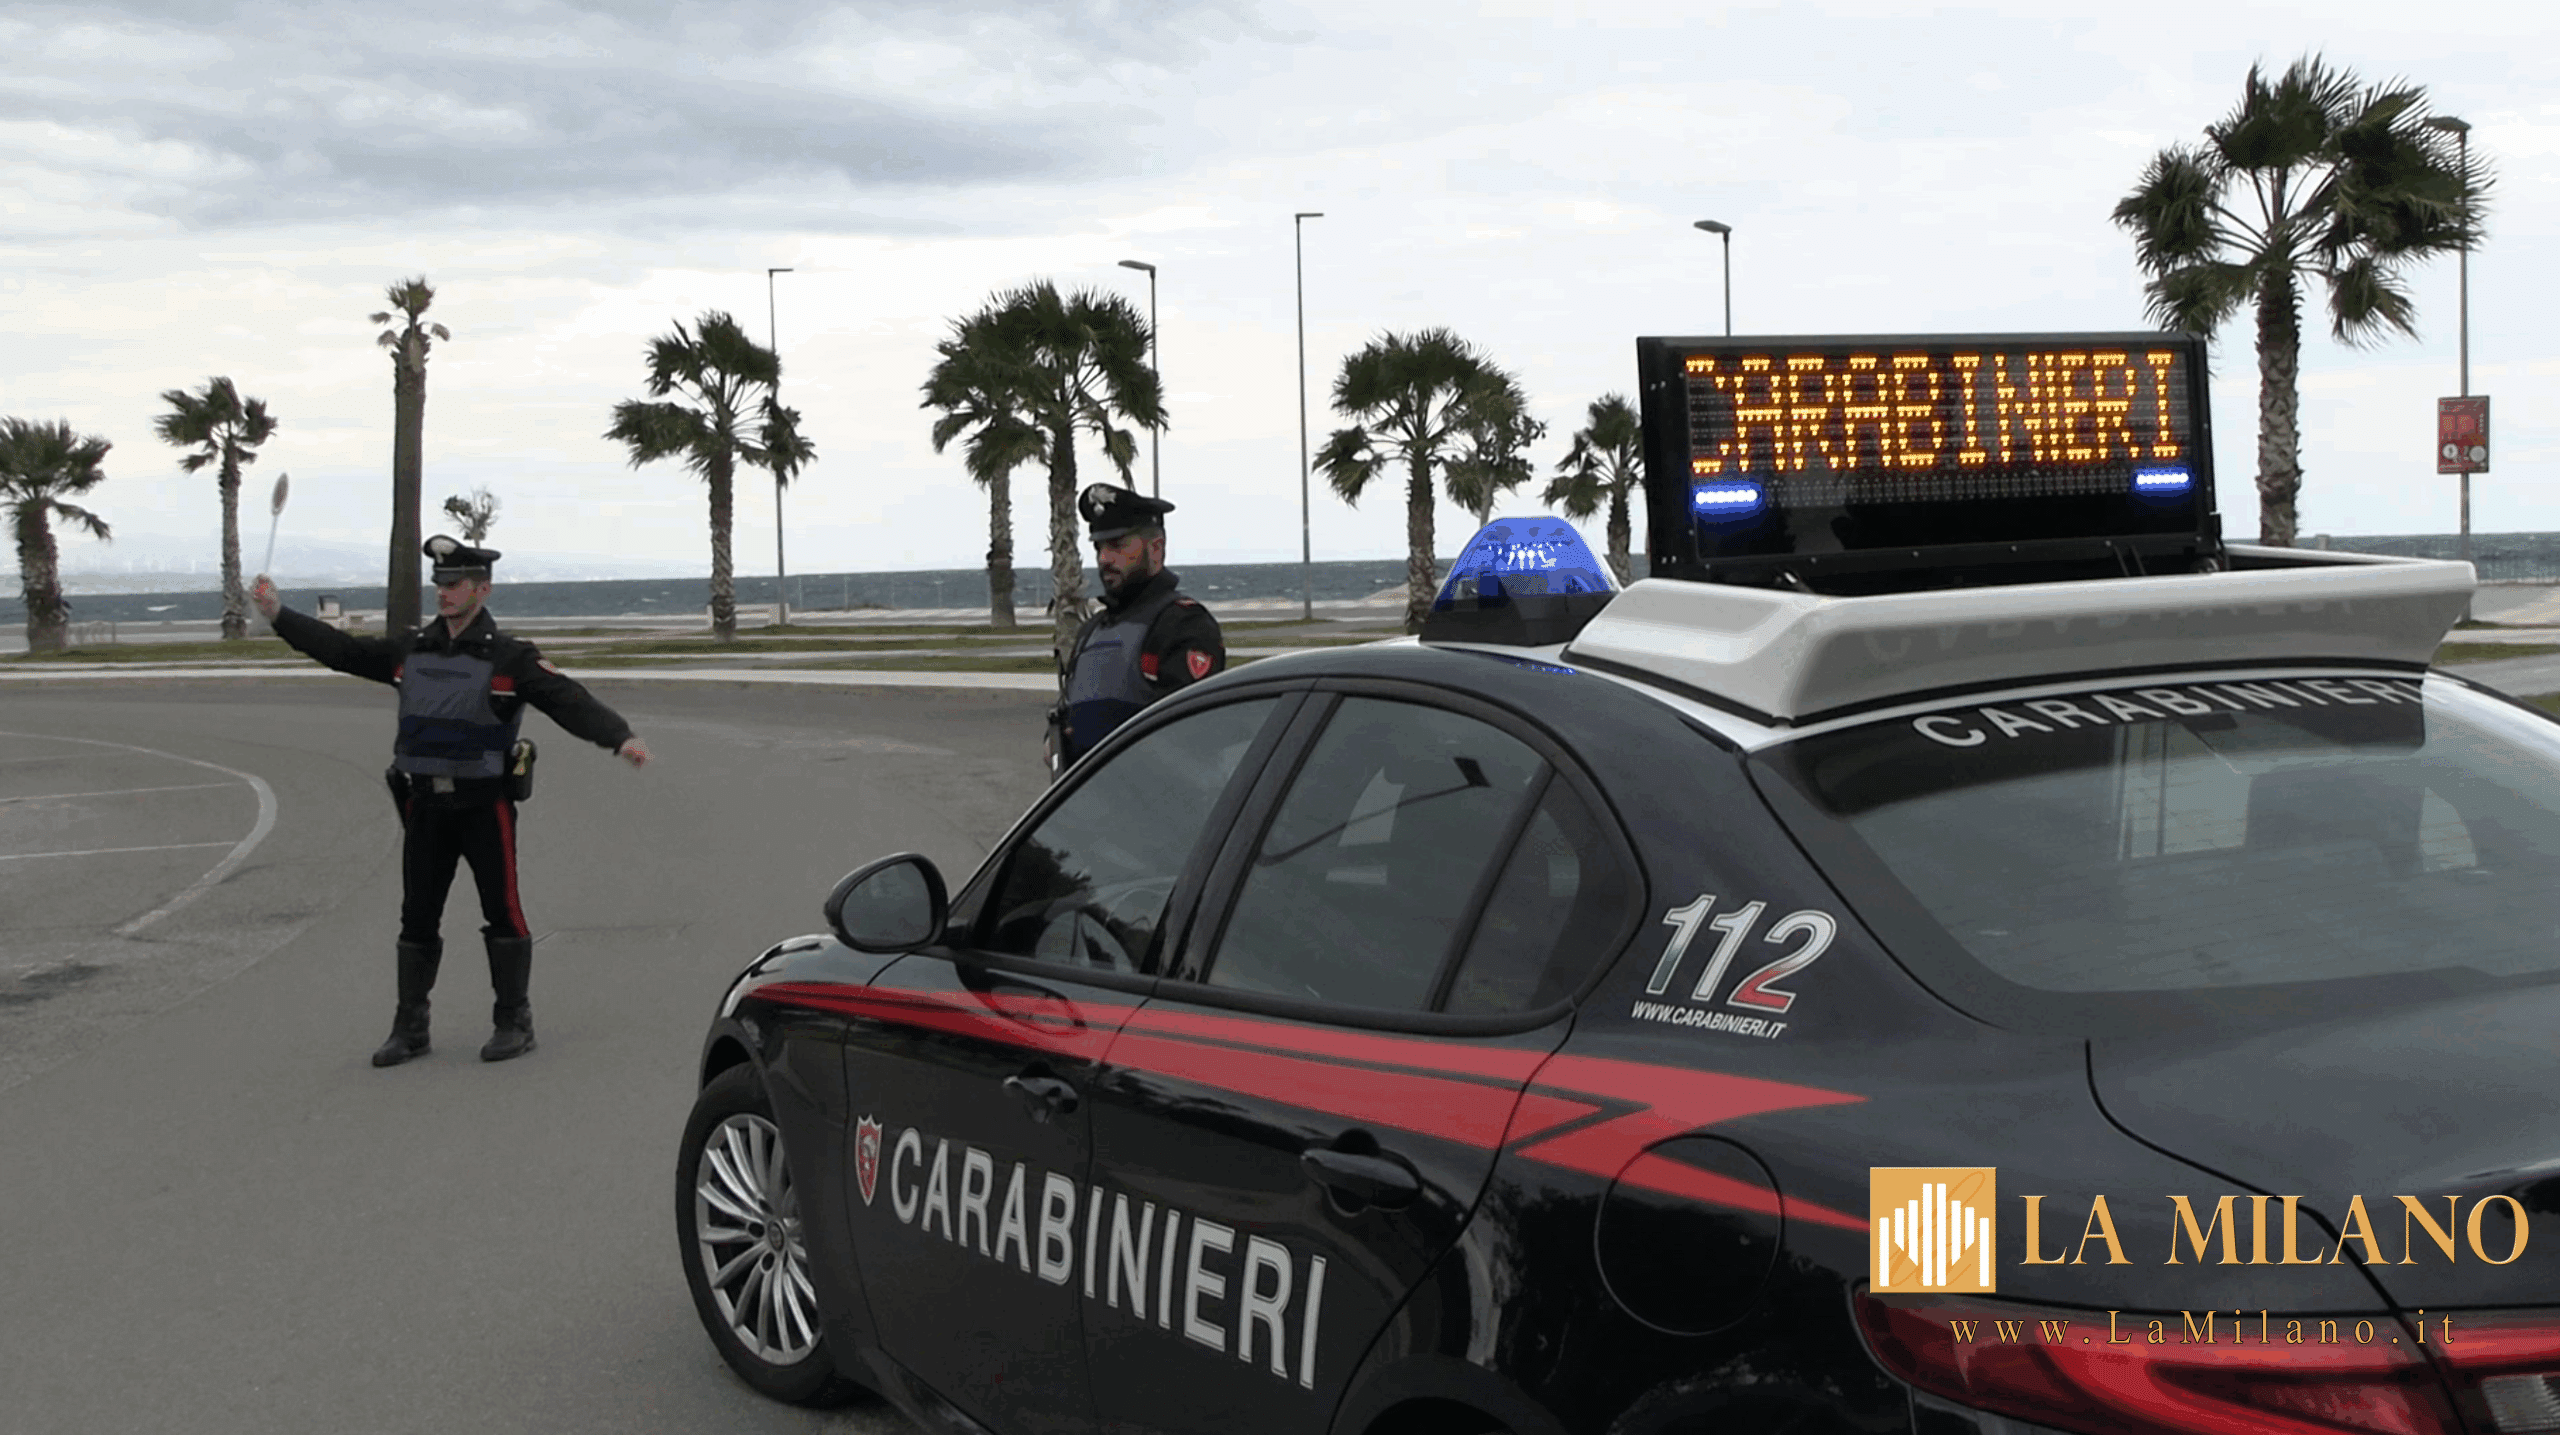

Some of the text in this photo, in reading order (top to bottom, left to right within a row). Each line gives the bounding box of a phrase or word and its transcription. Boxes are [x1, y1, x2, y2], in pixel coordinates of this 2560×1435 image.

[1685, 352, 2180, 474] CARABINIERI
[1912, 679, 2447, 747] CARABINIERI
[1645, 893, 1837, 1014] 112
[1631, 1000, 1788, 1039] WWW.CARABINIERI.IT
[890, 1126, 1327, 1390] CARABINIERI
